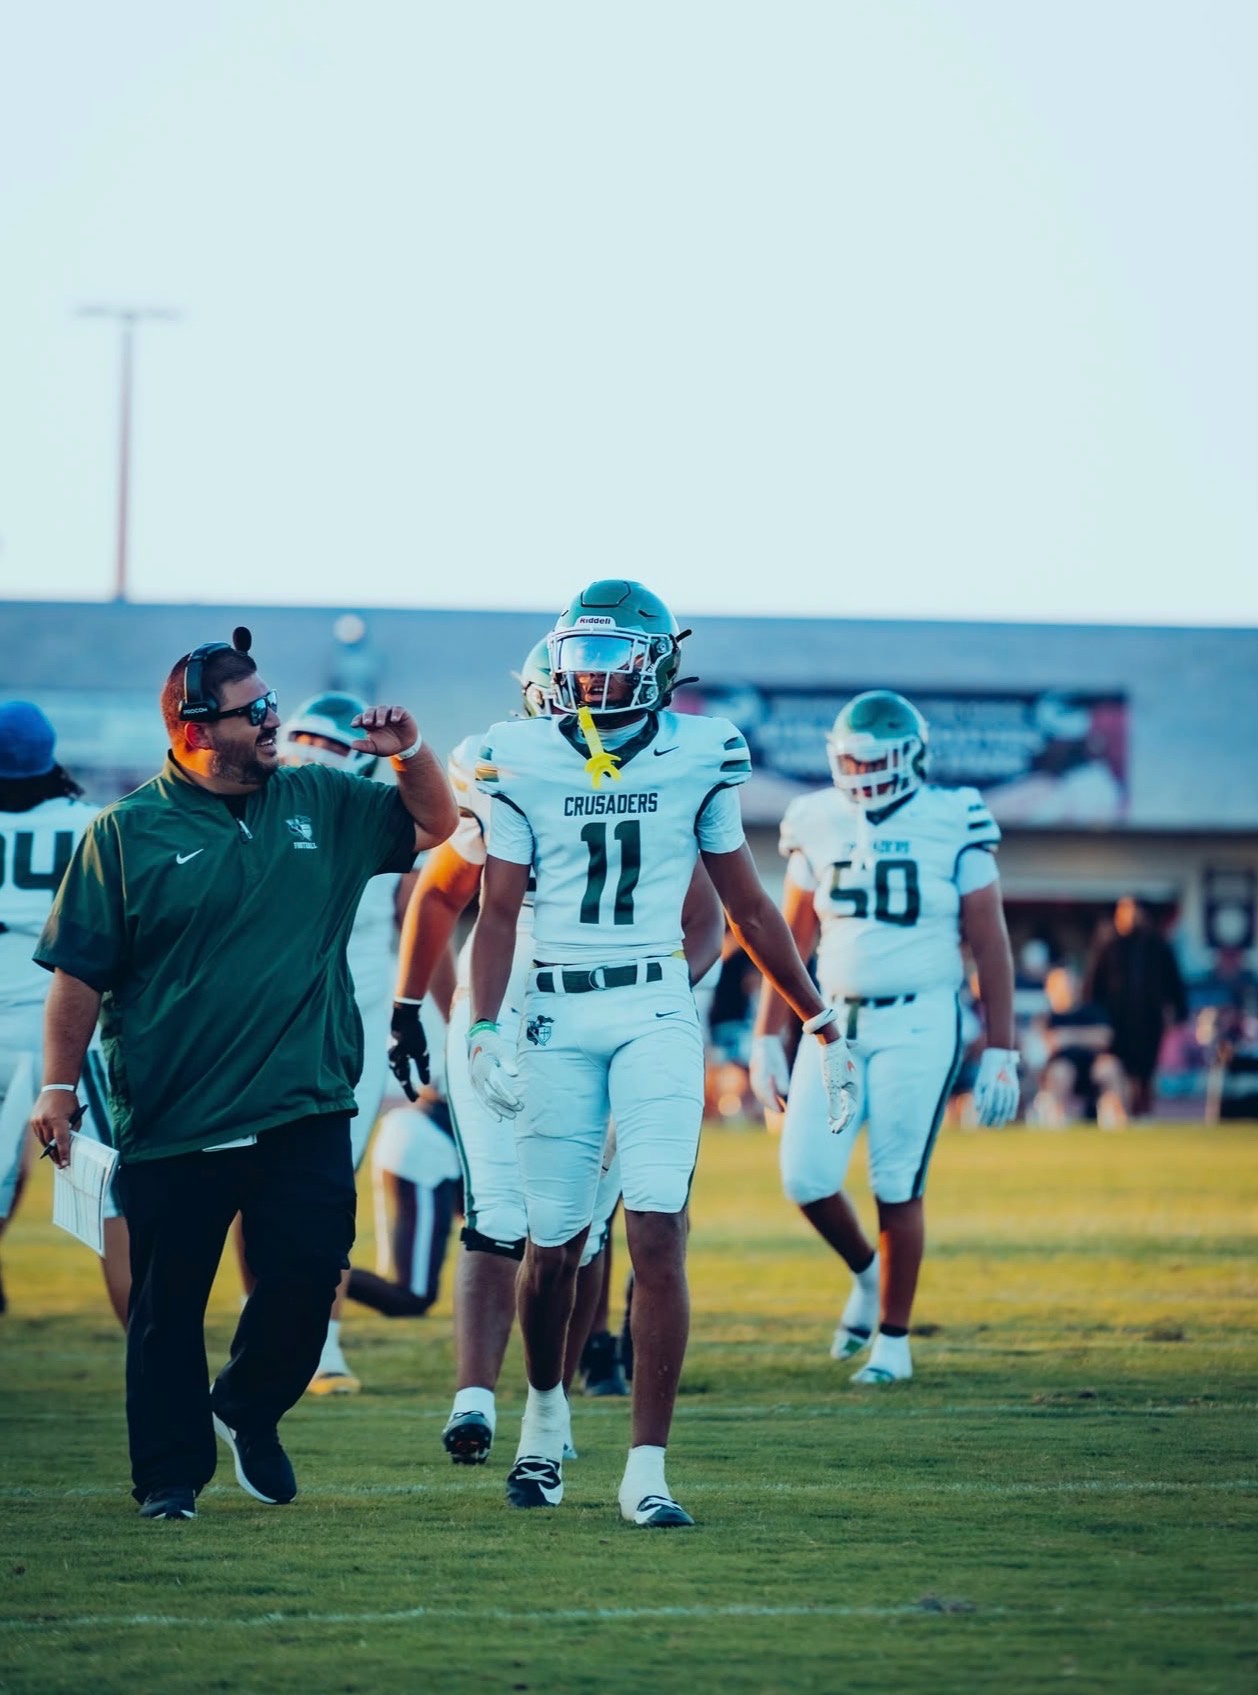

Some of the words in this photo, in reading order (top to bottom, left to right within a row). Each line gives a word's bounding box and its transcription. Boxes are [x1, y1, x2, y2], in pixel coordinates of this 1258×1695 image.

[183, 707, 208, 715] PROCOM
[564, 793, 658, 816] CRUSADERS
[0, 832, 73, 901] 4
[579, 820, 641, 925] 11
[830, 860, 919, 927] 50
